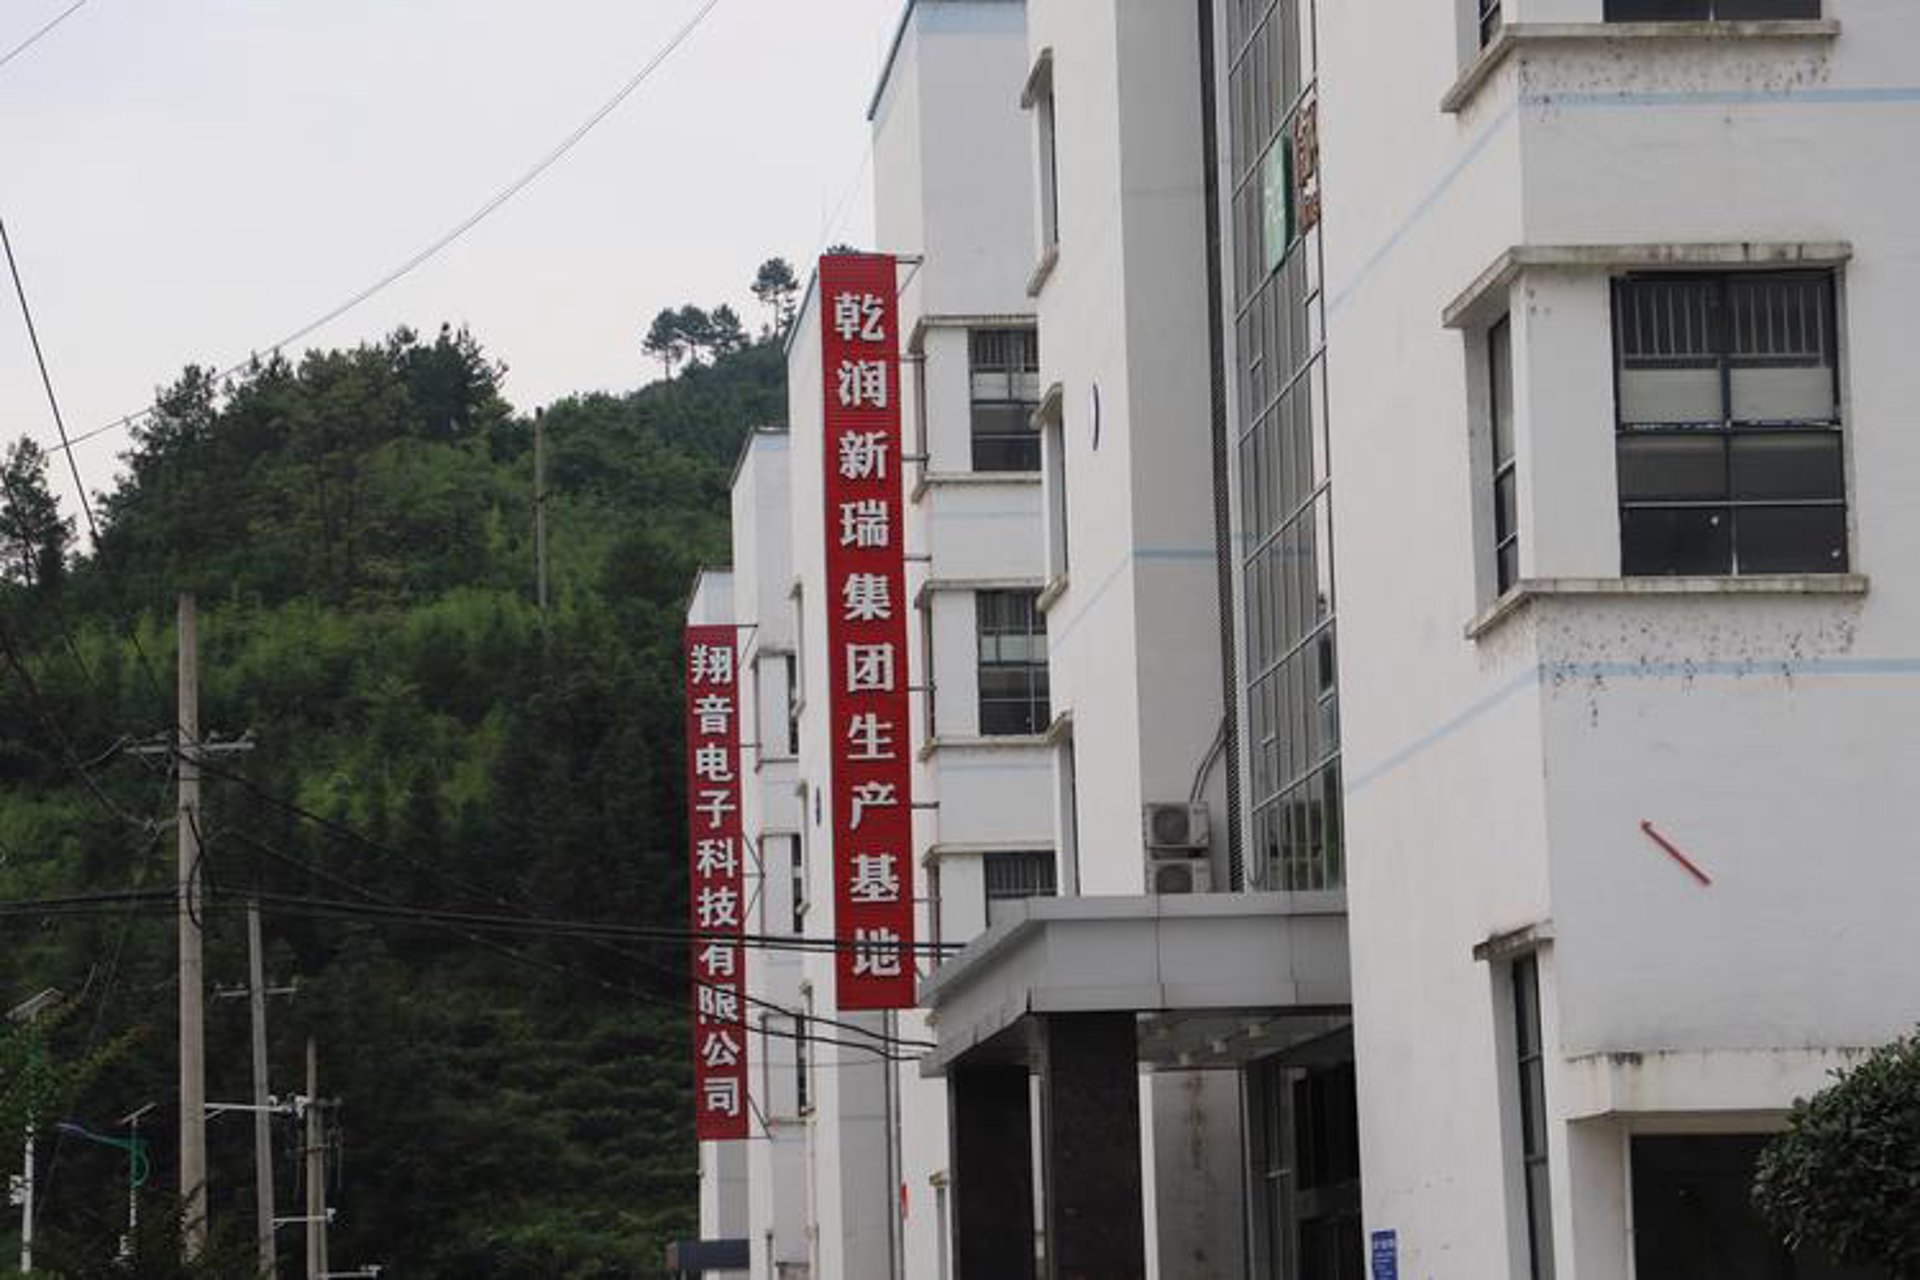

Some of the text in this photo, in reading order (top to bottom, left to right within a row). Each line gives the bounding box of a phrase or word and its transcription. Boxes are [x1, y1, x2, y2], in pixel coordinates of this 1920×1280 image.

[690, 643, 741, 1118] 翔音电子科技有限公司
[833, 291, 901, 978] 乾润新瑞集团生产基地
